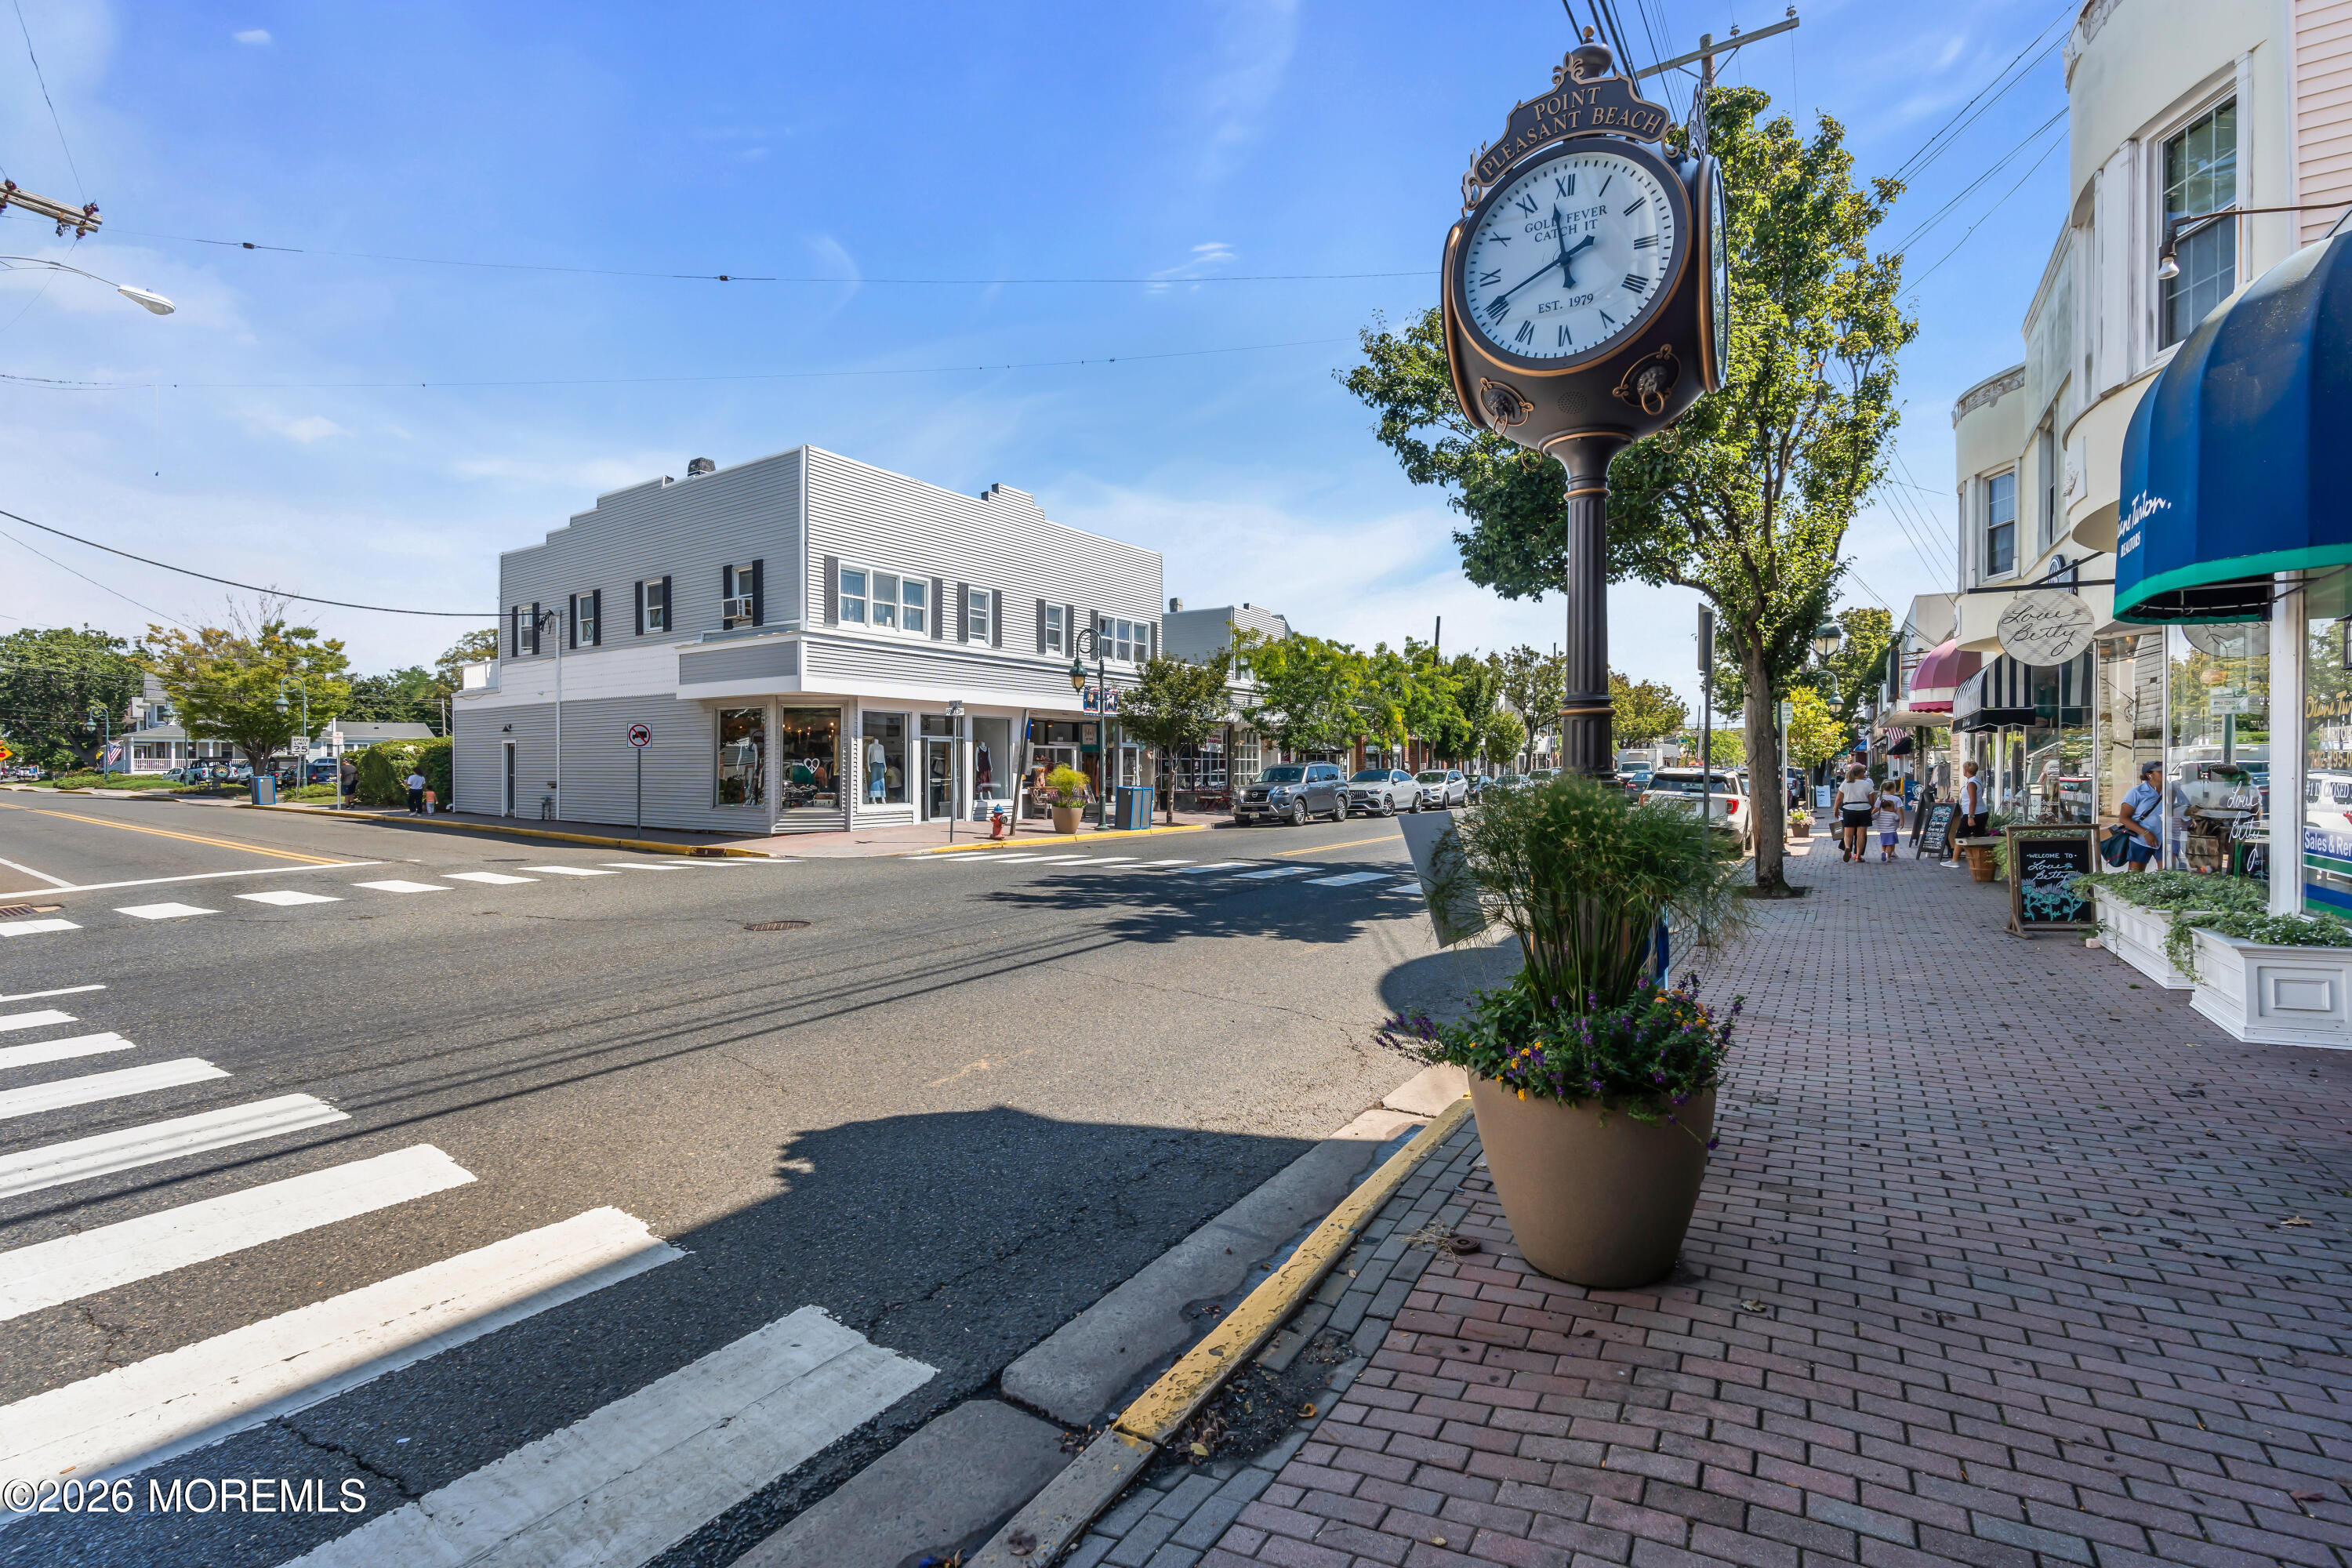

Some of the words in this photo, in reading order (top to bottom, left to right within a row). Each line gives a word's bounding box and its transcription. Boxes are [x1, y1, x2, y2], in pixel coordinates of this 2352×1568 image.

[1534, 86, 1601, 122] POINT
[1480, 111, 1581, 178] PLEASANT
[1591, 107, 1663, 135] BEACH
[1555, 173, 1576, 200] XII
[1515, 193, 1538, 219] XI
[1566, 205, 1608, 223] FEVER
[1623, 196, 1646, 216] II
[1534, 224, 1577, 242] CATCH
[1584, 219, 1599, 230] IT
[1633, 234, 1659, 250] III
[1537, 300, 1563, 314] EST.
[1569, 293, 1595, 307] 1979
[2120, 531, 2141, 558] REALTORS
[2007, 622, 2092, 657] Betty
[2305, 695, 2336, 719] Diane
[2229, 811, 2266, 872] Betty
[2304, 831, 2327, 852] Sales
[2328, 834, 2336, 854] &
